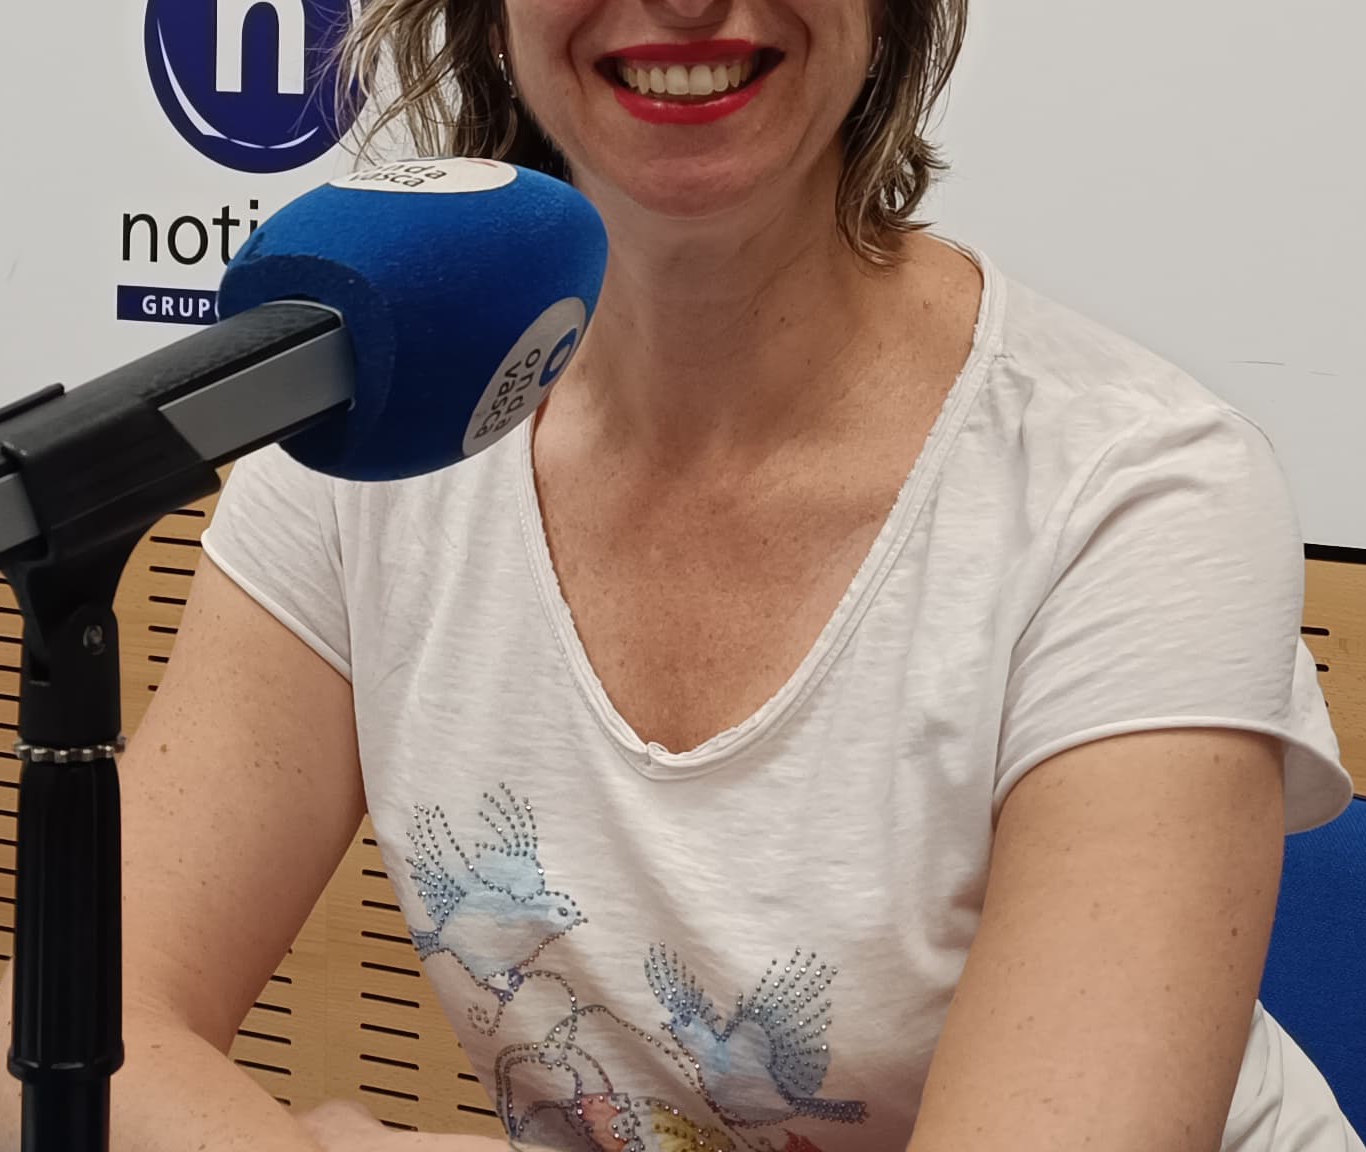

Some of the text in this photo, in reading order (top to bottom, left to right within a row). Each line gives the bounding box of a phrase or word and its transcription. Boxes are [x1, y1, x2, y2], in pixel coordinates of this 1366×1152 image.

[121, 199, 259, 266] noti
[141, 294, 220, 318] GRUP
[472, 360, 522, 440] vasca
